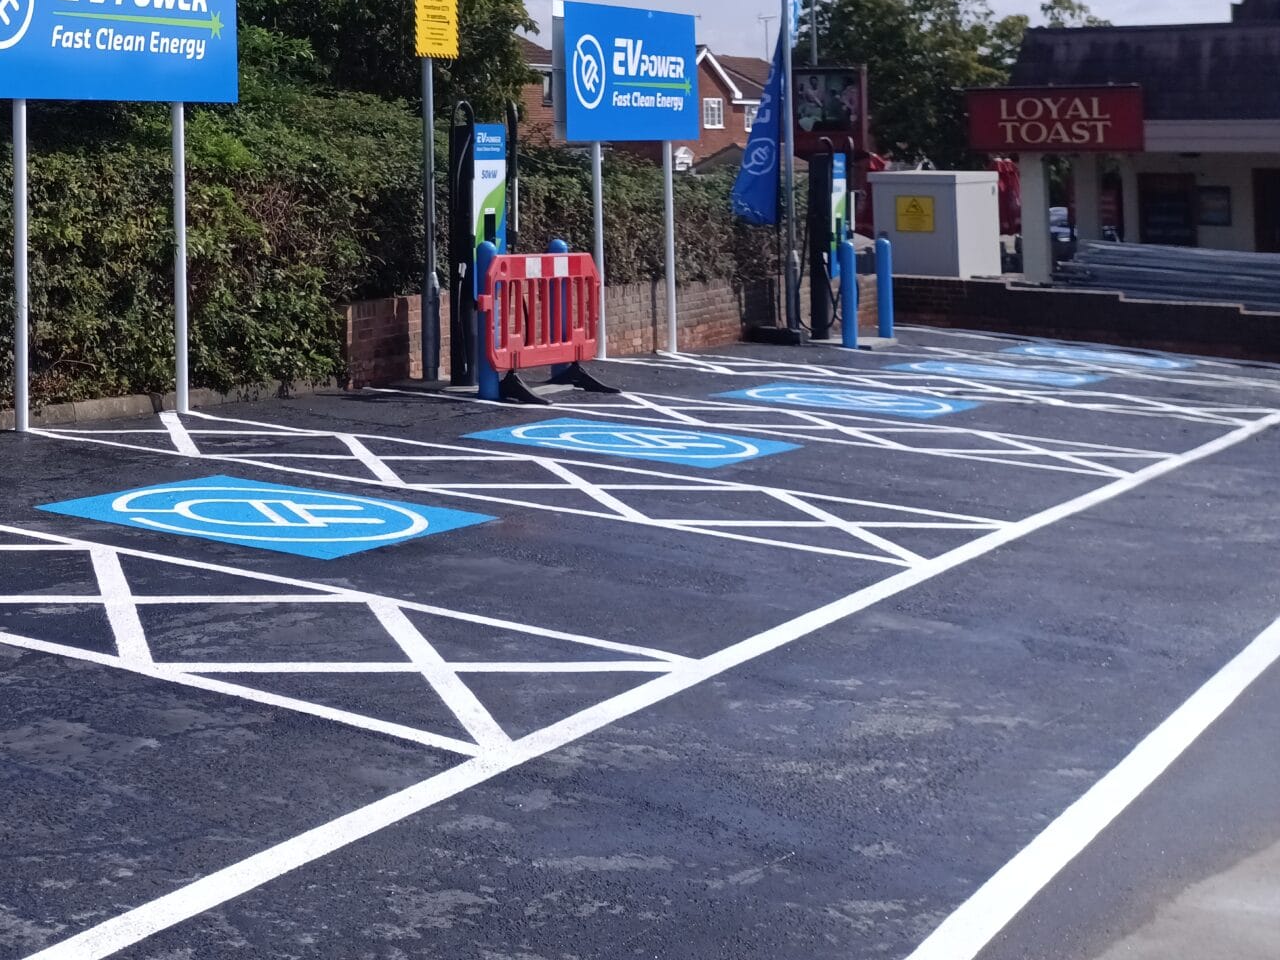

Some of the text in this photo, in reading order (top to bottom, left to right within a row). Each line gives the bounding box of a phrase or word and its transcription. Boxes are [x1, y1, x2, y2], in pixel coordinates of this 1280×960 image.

[51, 25, 207, 60] Fast Clean Energy
[612, 90, 685, 112] Fast Clean Energy
[999, 96, 1112, 121] LOYAL
[997, 121, 1113, 144] TOAST
